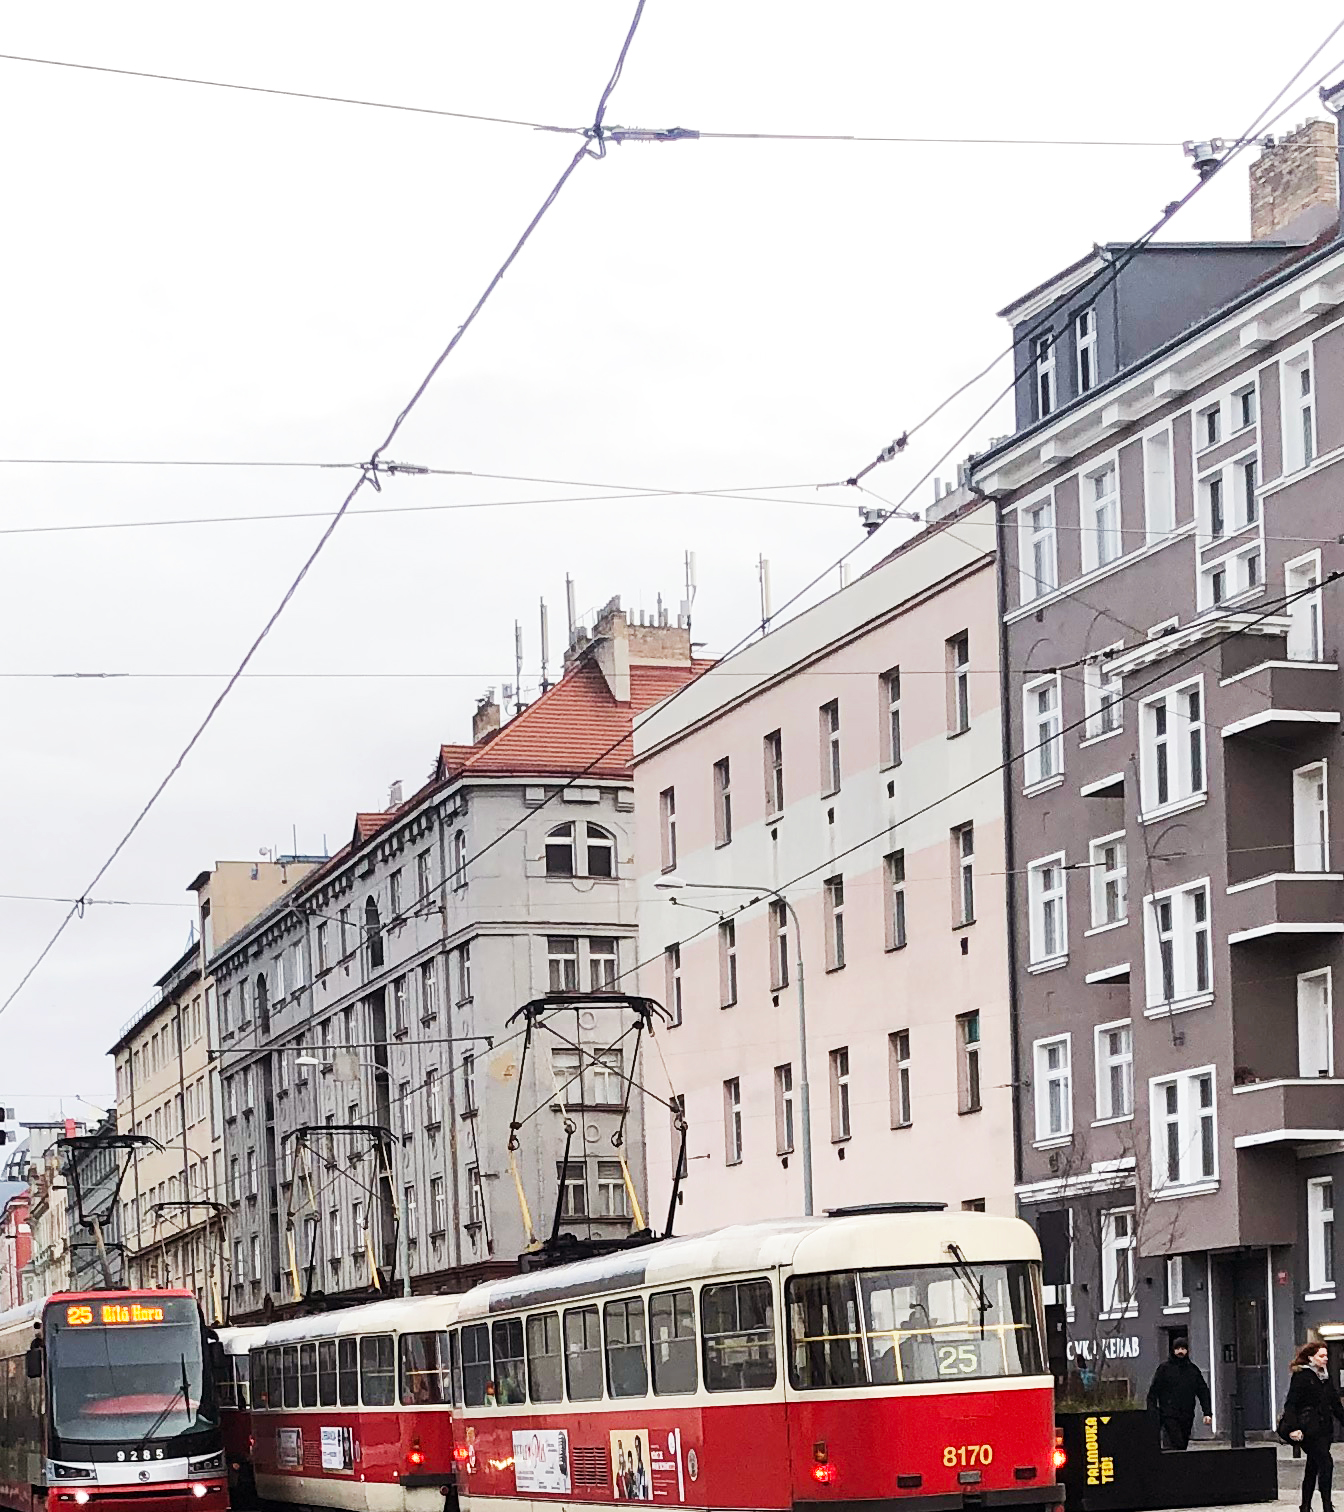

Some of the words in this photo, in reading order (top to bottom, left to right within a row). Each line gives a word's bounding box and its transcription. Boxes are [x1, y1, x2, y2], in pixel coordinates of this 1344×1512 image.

[67, 1306, 93, 1325] 25
[131, 1303, 165, 1322] Hora
[938, 1344, 978, 1375] 25
[116, 1448, 164, 1462] 9285
[943, 1444, 993, 1467] 8170
